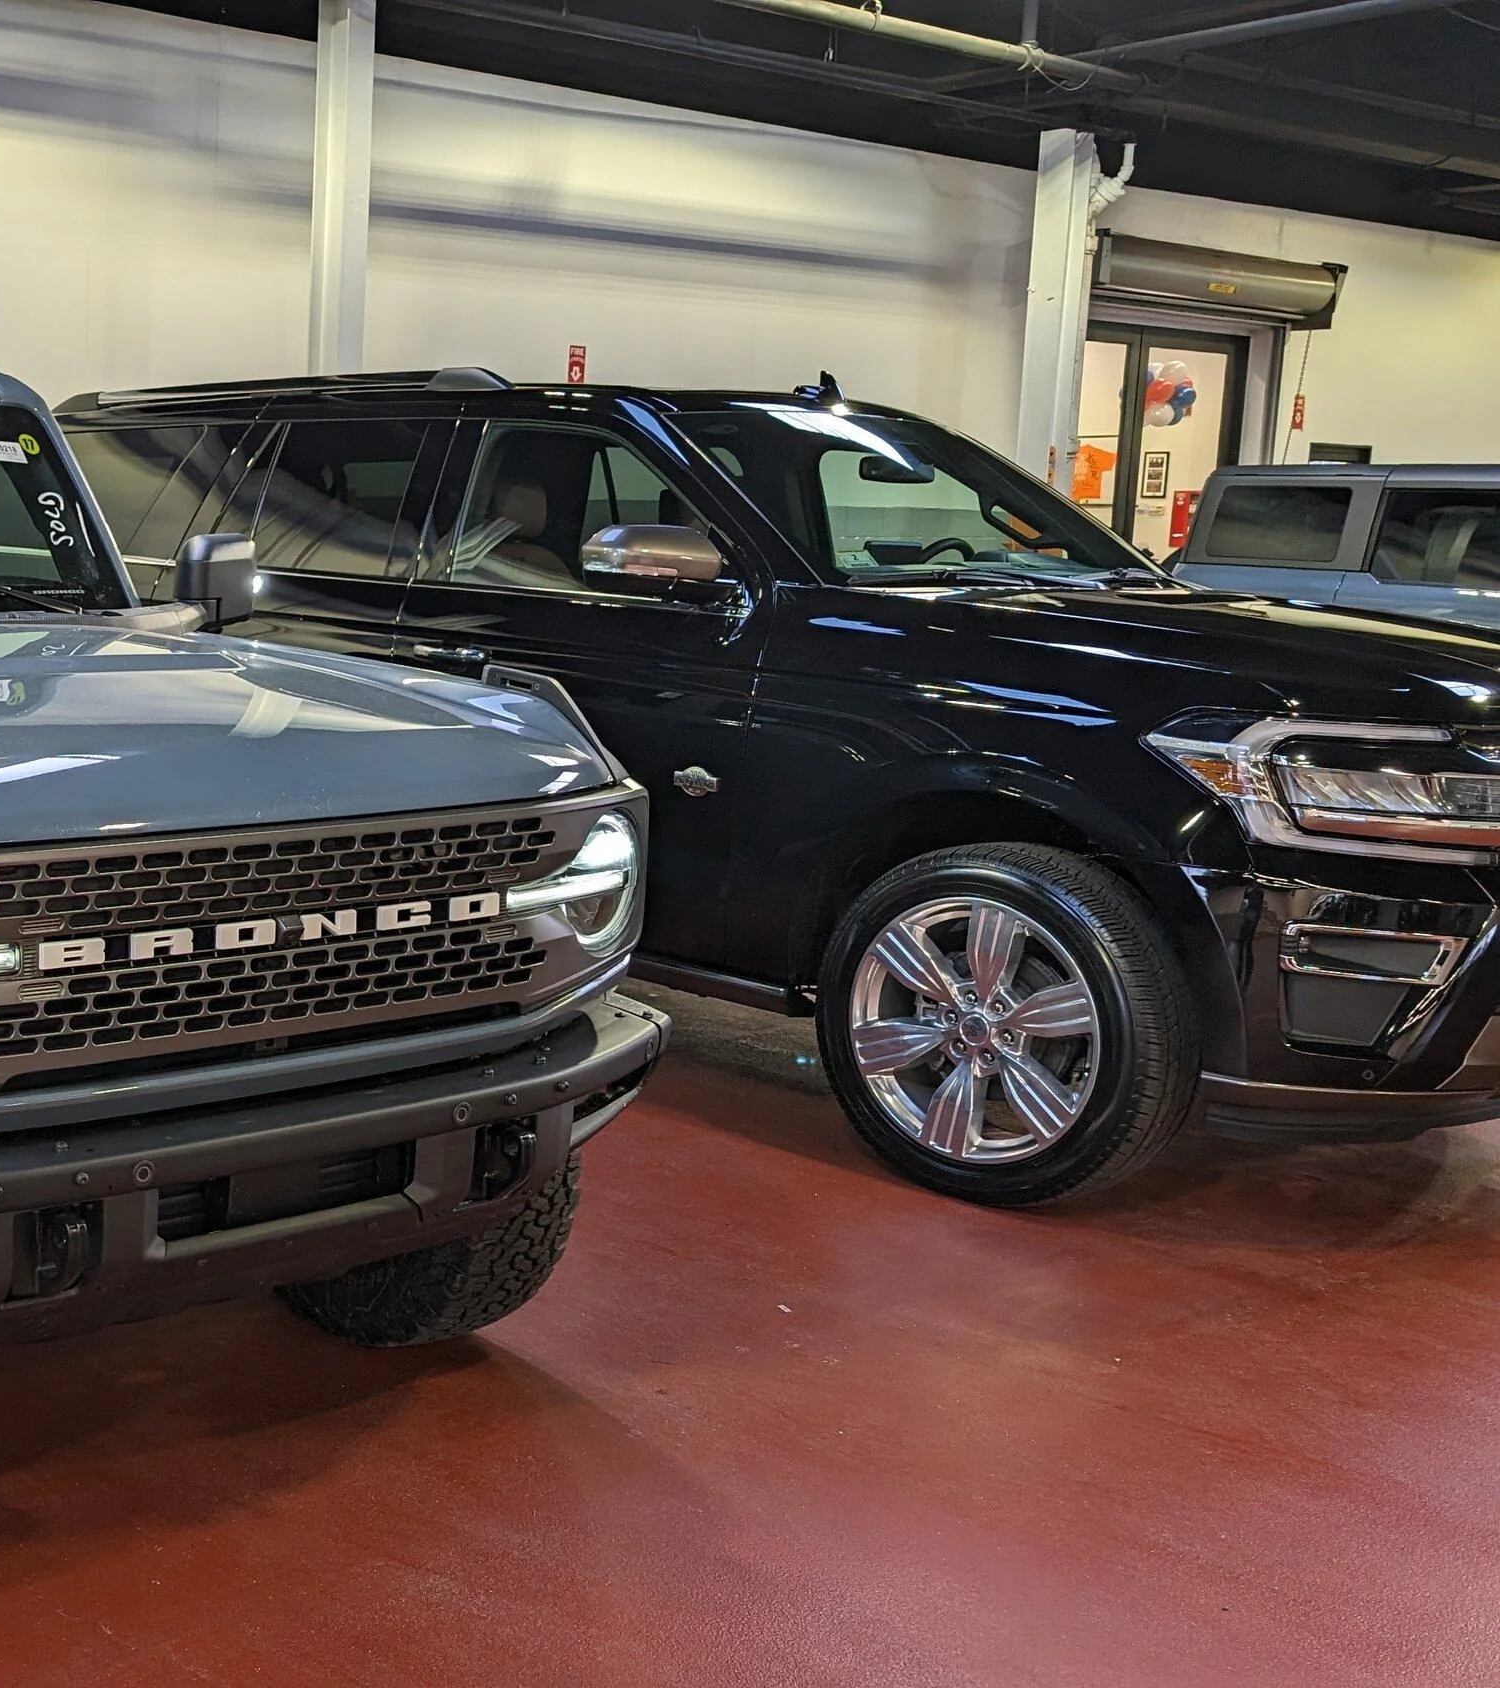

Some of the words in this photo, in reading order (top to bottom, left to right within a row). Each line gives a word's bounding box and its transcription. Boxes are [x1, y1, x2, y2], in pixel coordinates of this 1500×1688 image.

[570, 347, 585, 355] FIRE
[22, 438, 35, 451] 17
[39, 891, 501, 971] BRONCO
